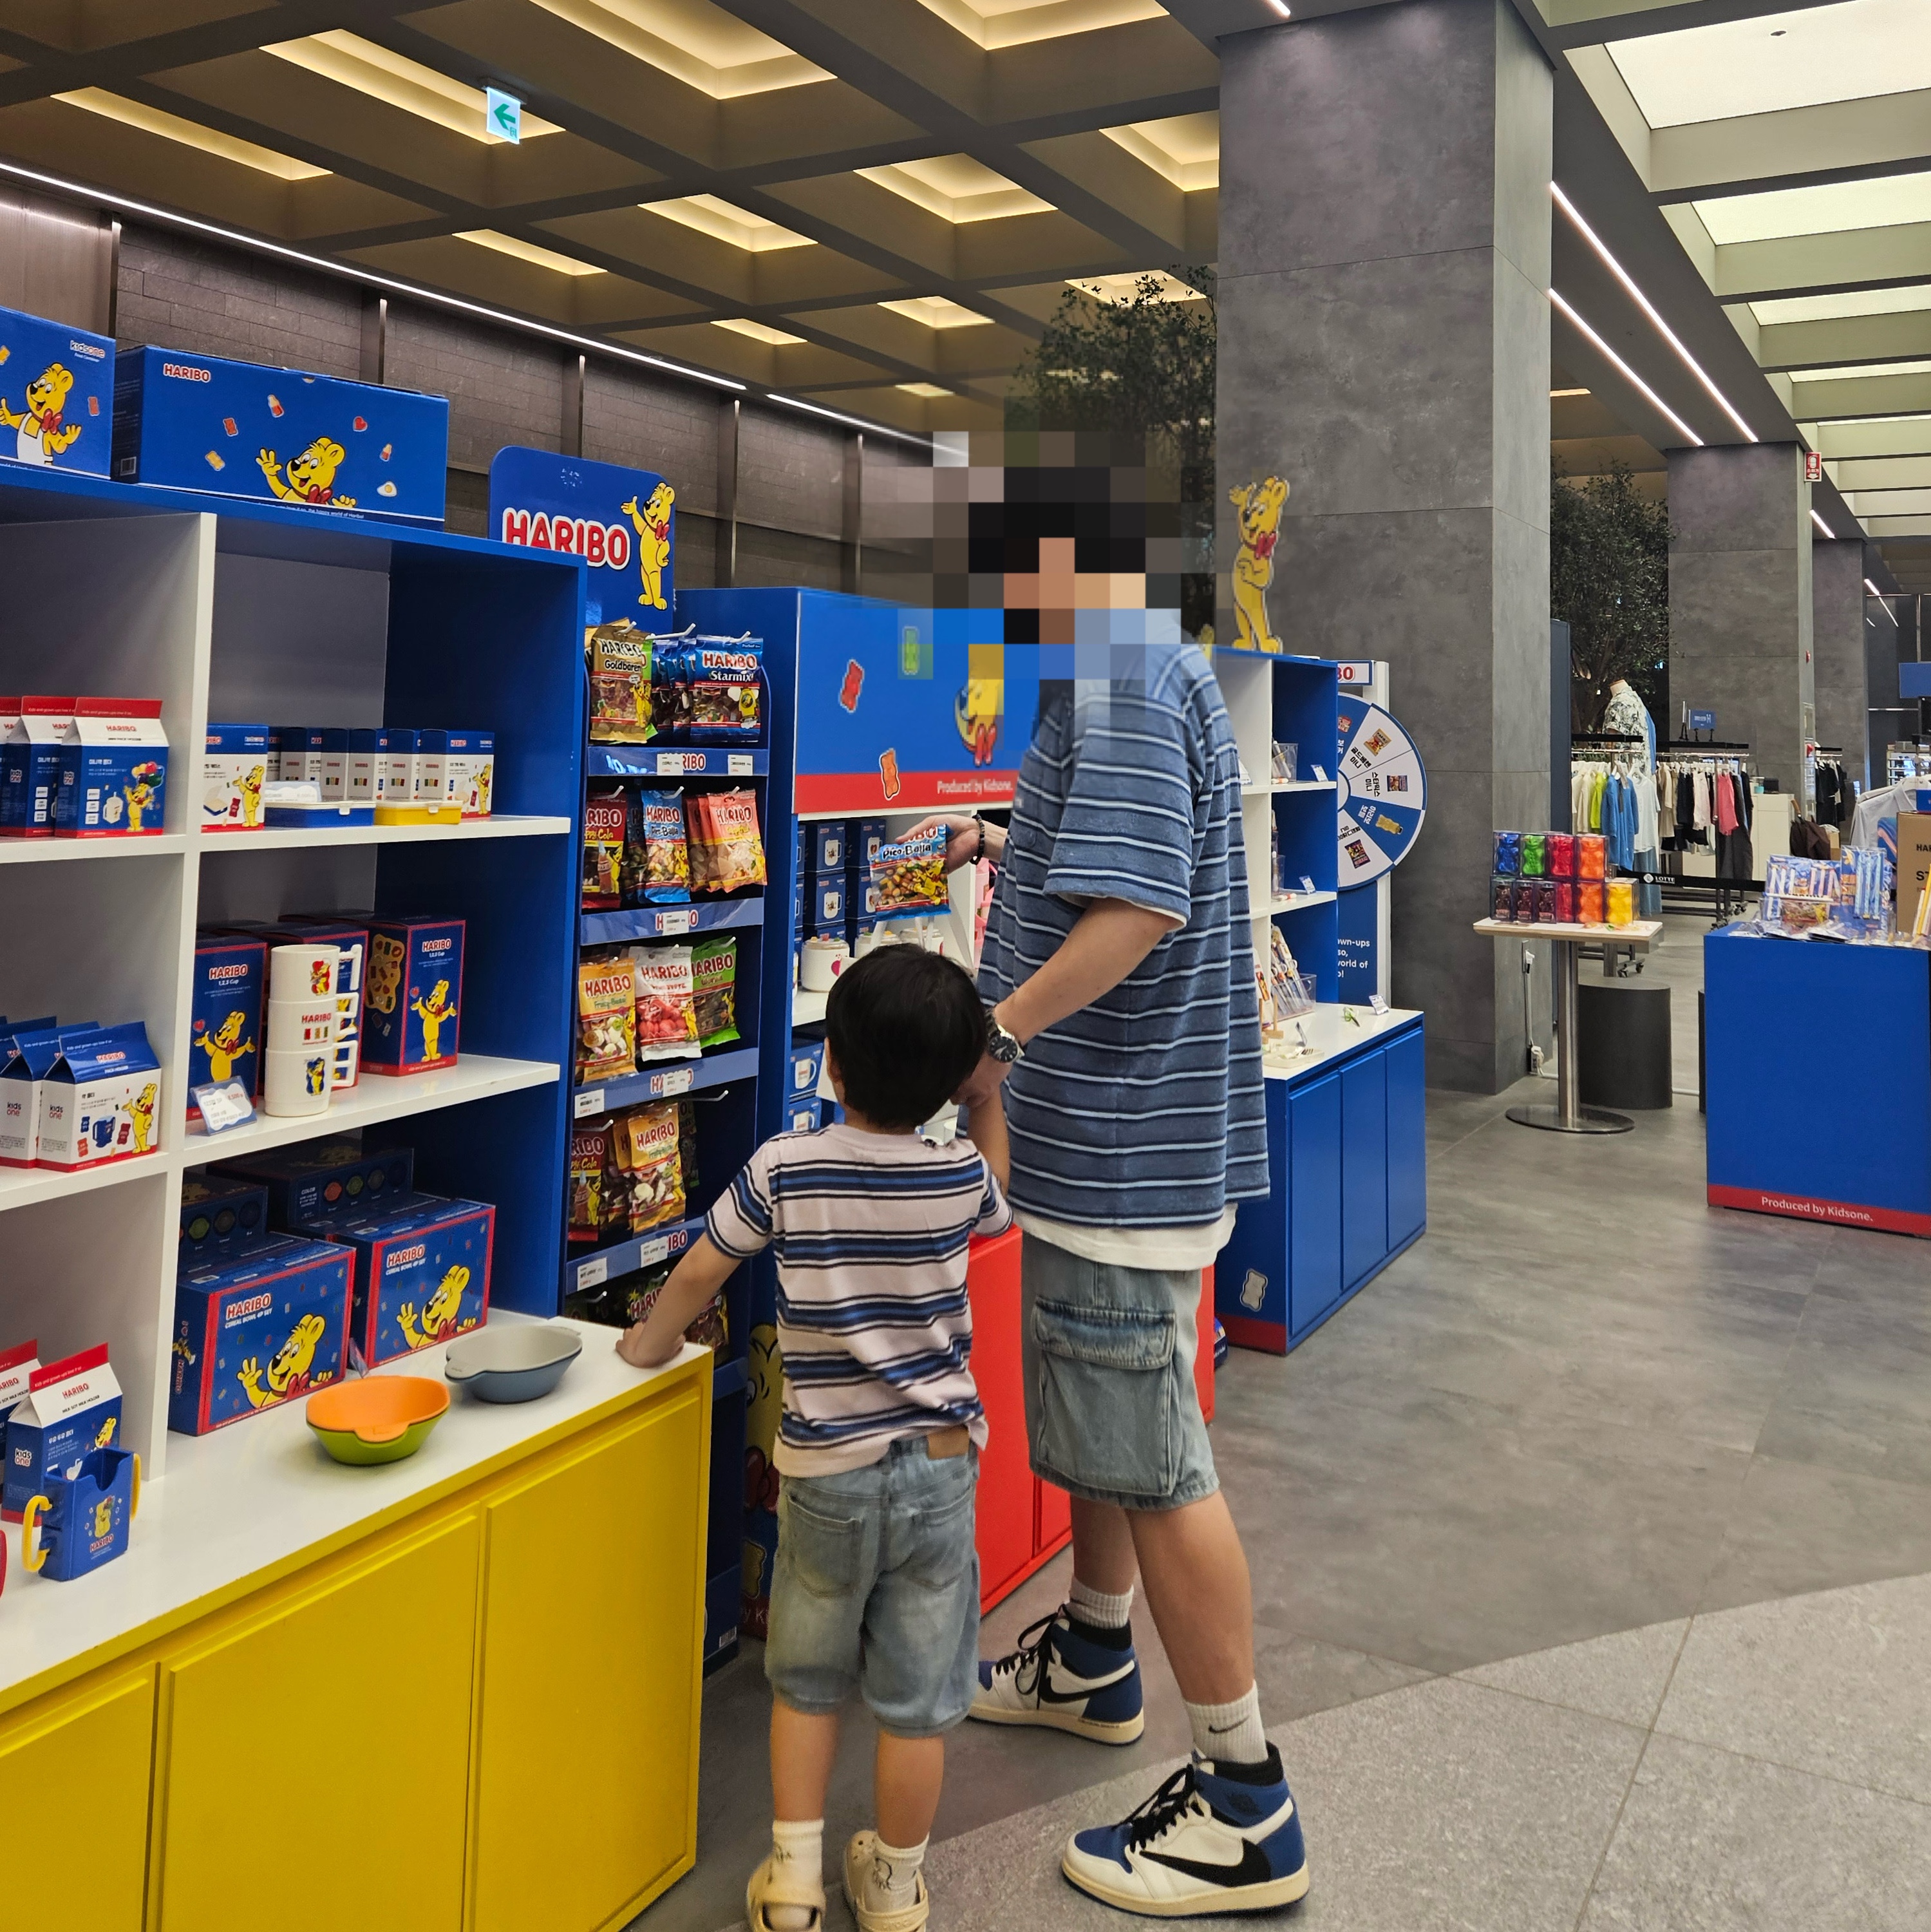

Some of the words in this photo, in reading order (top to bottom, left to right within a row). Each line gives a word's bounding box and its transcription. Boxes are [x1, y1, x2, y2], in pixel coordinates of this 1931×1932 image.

[164, 363, 211, 383] HARIBO
[502, 507, 630, 570] HARIBO
[702, 650, 757, 670] HARIBO
[1350, 756, 1362, 769] 미니
[1366, 779, 1373, 791] 미니
[1372, 772, 1380, 797] 스타믹스
[646, 804, 681, 824] HARIBO
[716, 805, 753, 825] HARIBO
[422, 938, 451, 952] HARIBO
[209, 964, 248, 980] HARIBO
[641, 965, 689, 980] HARIBO
[585, 974, 632, 998] HARIBO
[301, 1012, 332, 1024] HARIBO
[96, 1052, 126, 1064] HARIBO
[7, 1102, 21, 1110] kids
[50, 1104, 63, 1113] kids
[636, 1121, 676, 1151] HARIBO
[1762, 1196, 1810, 1213] Produced
[1813, 1204, 1825, 1217] by
[1827, 1206, 1874, 1222] Kidsone.
[387, 1244, 426, 1268] HARIBO
[226, 1293, 271, 1320] HARIBO
[62, 1383, 89, 1399] HARIBO
[15, 1448, 32, 1459] kids
[15, 1457, 30, 1467] one
[90, 1533, 114, 1553] HARIBO
